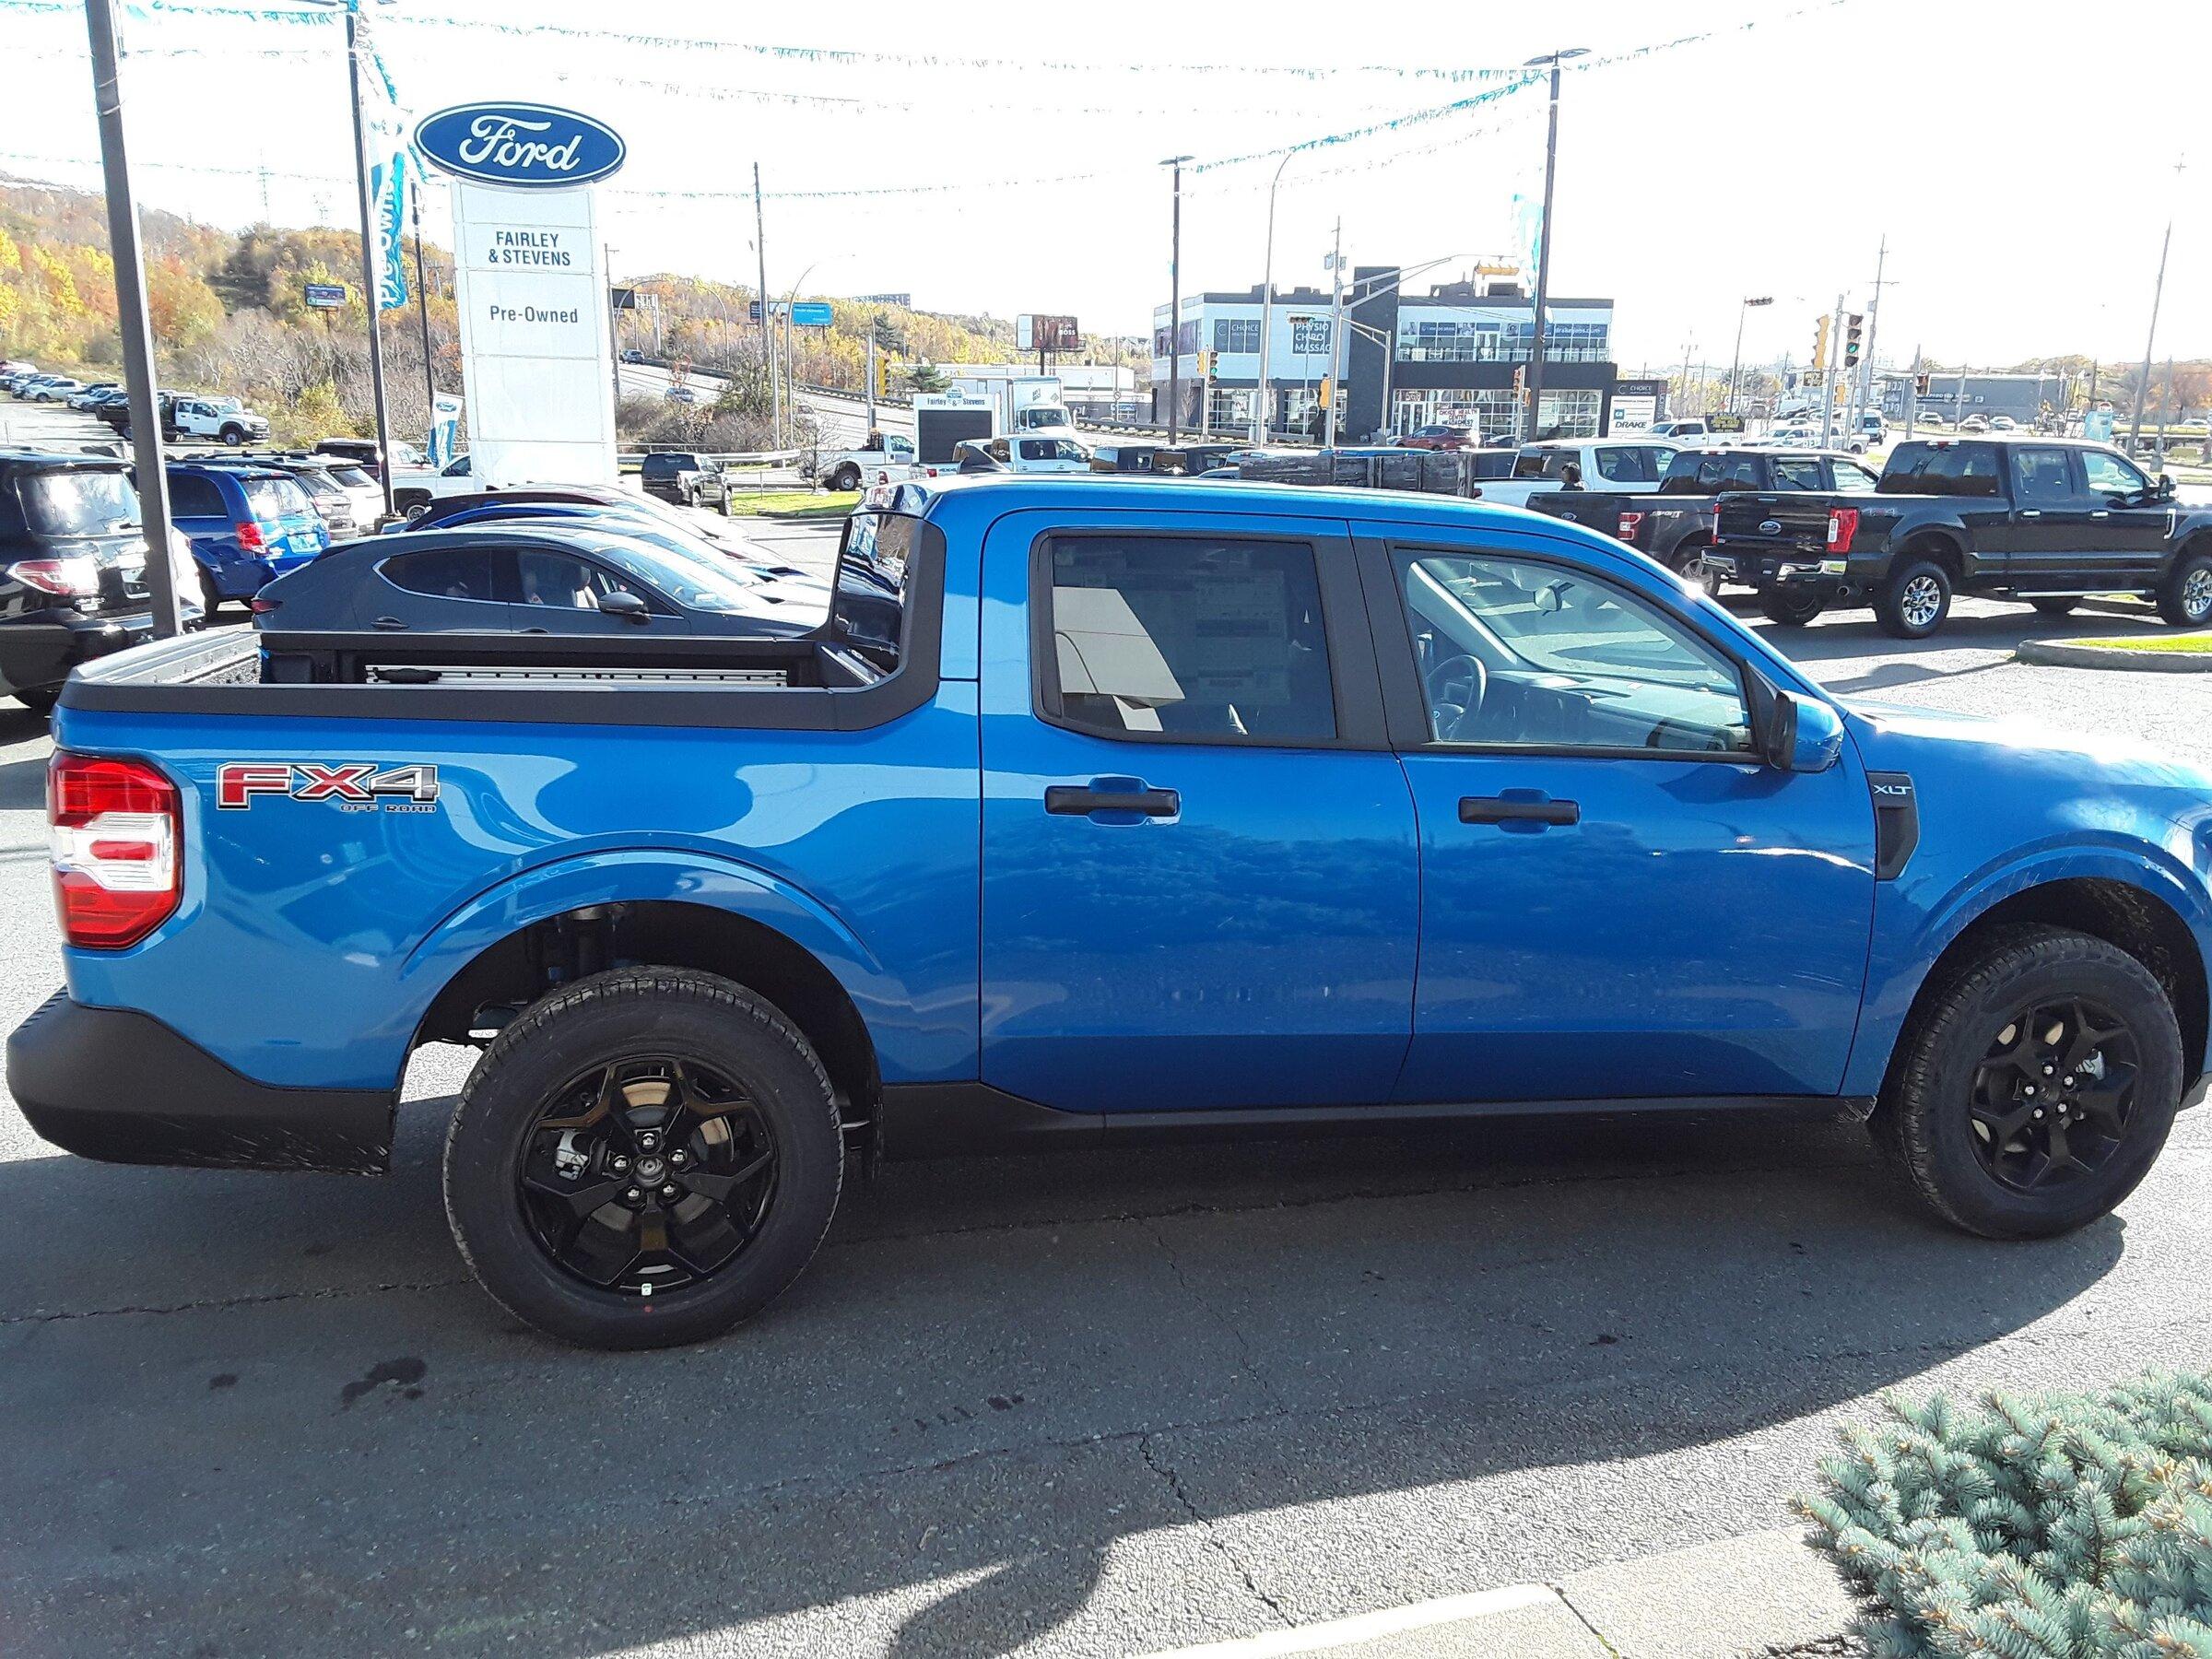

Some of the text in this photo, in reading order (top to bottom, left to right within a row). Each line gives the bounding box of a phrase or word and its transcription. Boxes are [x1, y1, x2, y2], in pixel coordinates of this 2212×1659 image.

[459, 115, 582, 171] Ford
[496, 231, 559, 248] FAIRLEY
[488, 249, 571, 266] & STEVENS
[490, 305, 578, 323] Pre-Owned
[1230, 324, 1259, 332] CHOICE
[1296, 323, 1329, 331] PHYSIO
[1295, 333, 1324, 341] CHRO
[926, 397, 947, 406] Fairley
[962, 397, 985, 406] Stevens
[217, 761, 441, 811] FX4
[1873, 784, 1912, 795] XLT
[340, 804, 438, 813] OFF ROAD
